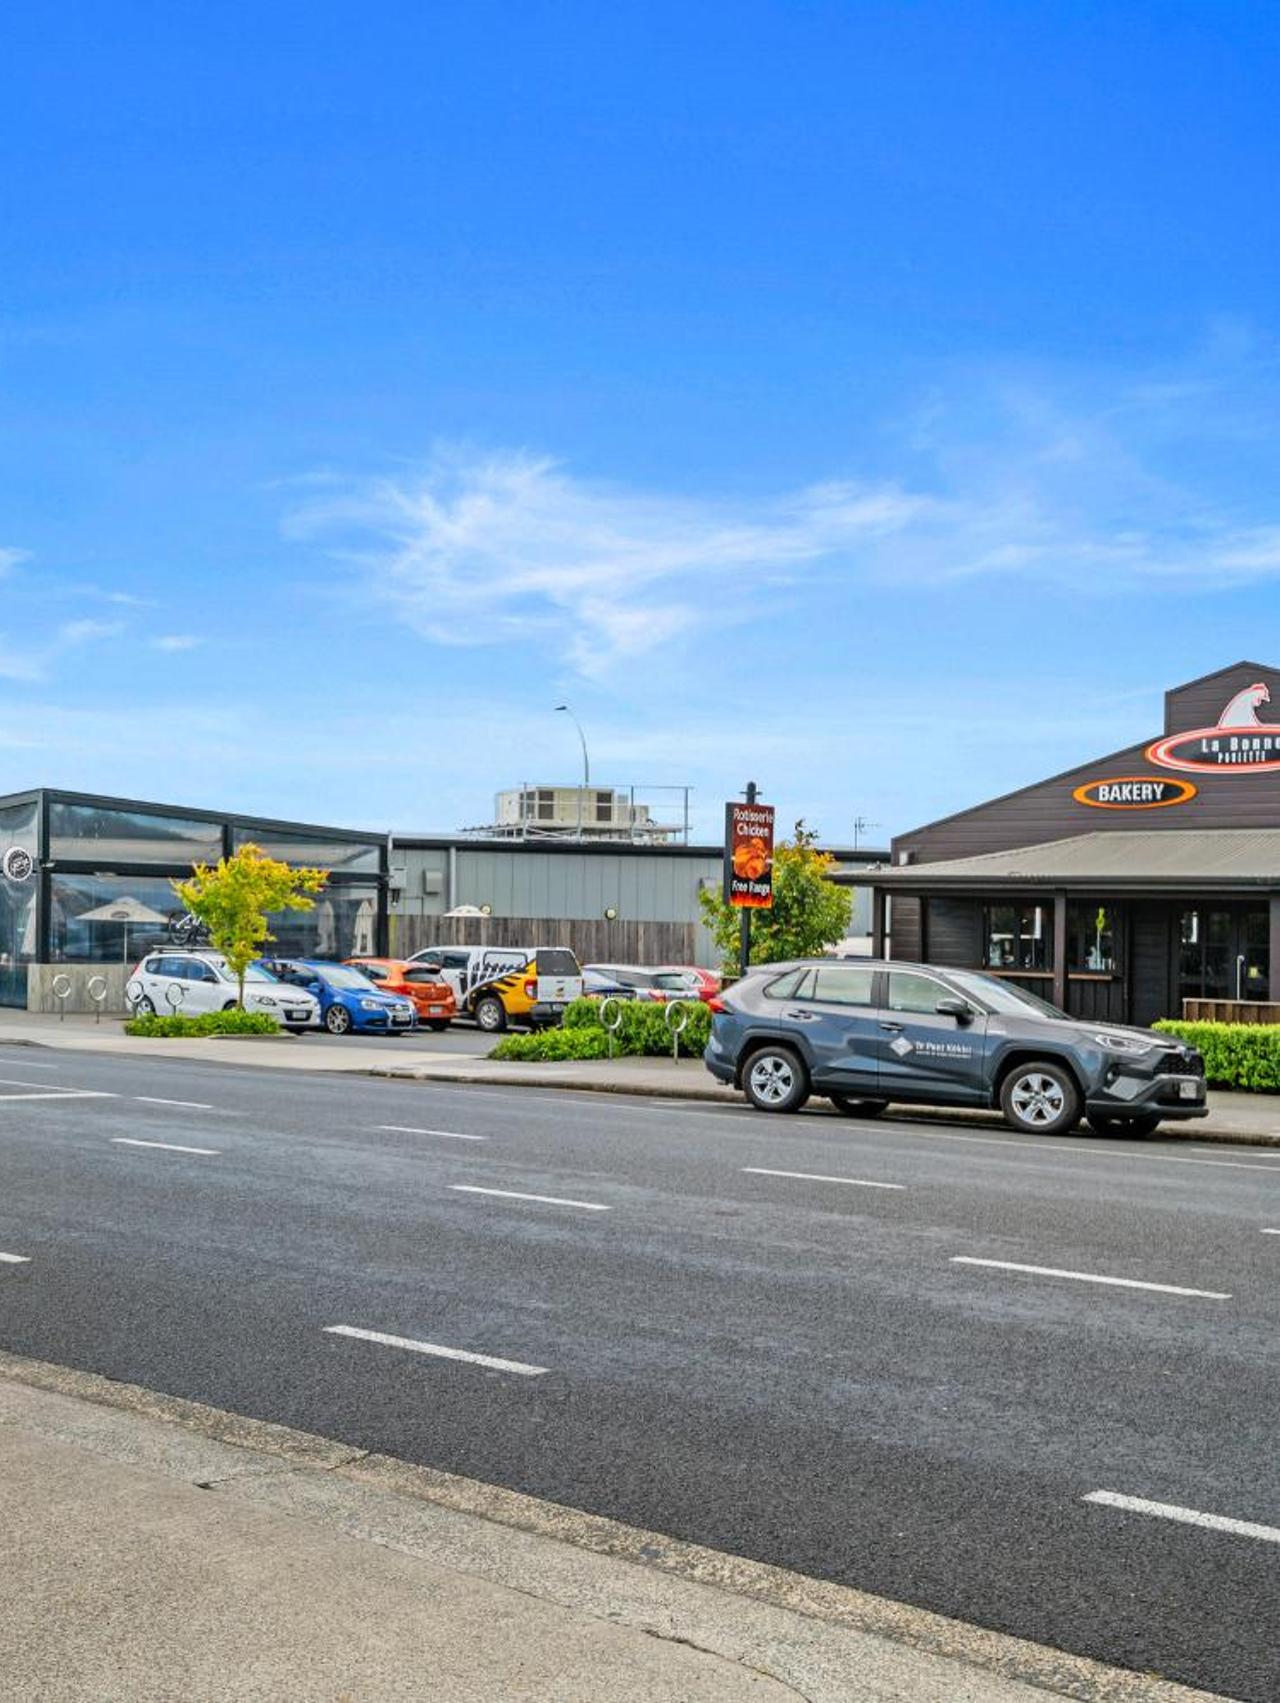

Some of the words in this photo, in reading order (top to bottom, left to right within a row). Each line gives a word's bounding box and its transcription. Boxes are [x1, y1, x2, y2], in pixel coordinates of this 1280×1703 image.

[1202, 738, 1219, 753] La
[1098, 783, 1164, 801] BAKERY
[736, 822, 769, 836] Chicken
